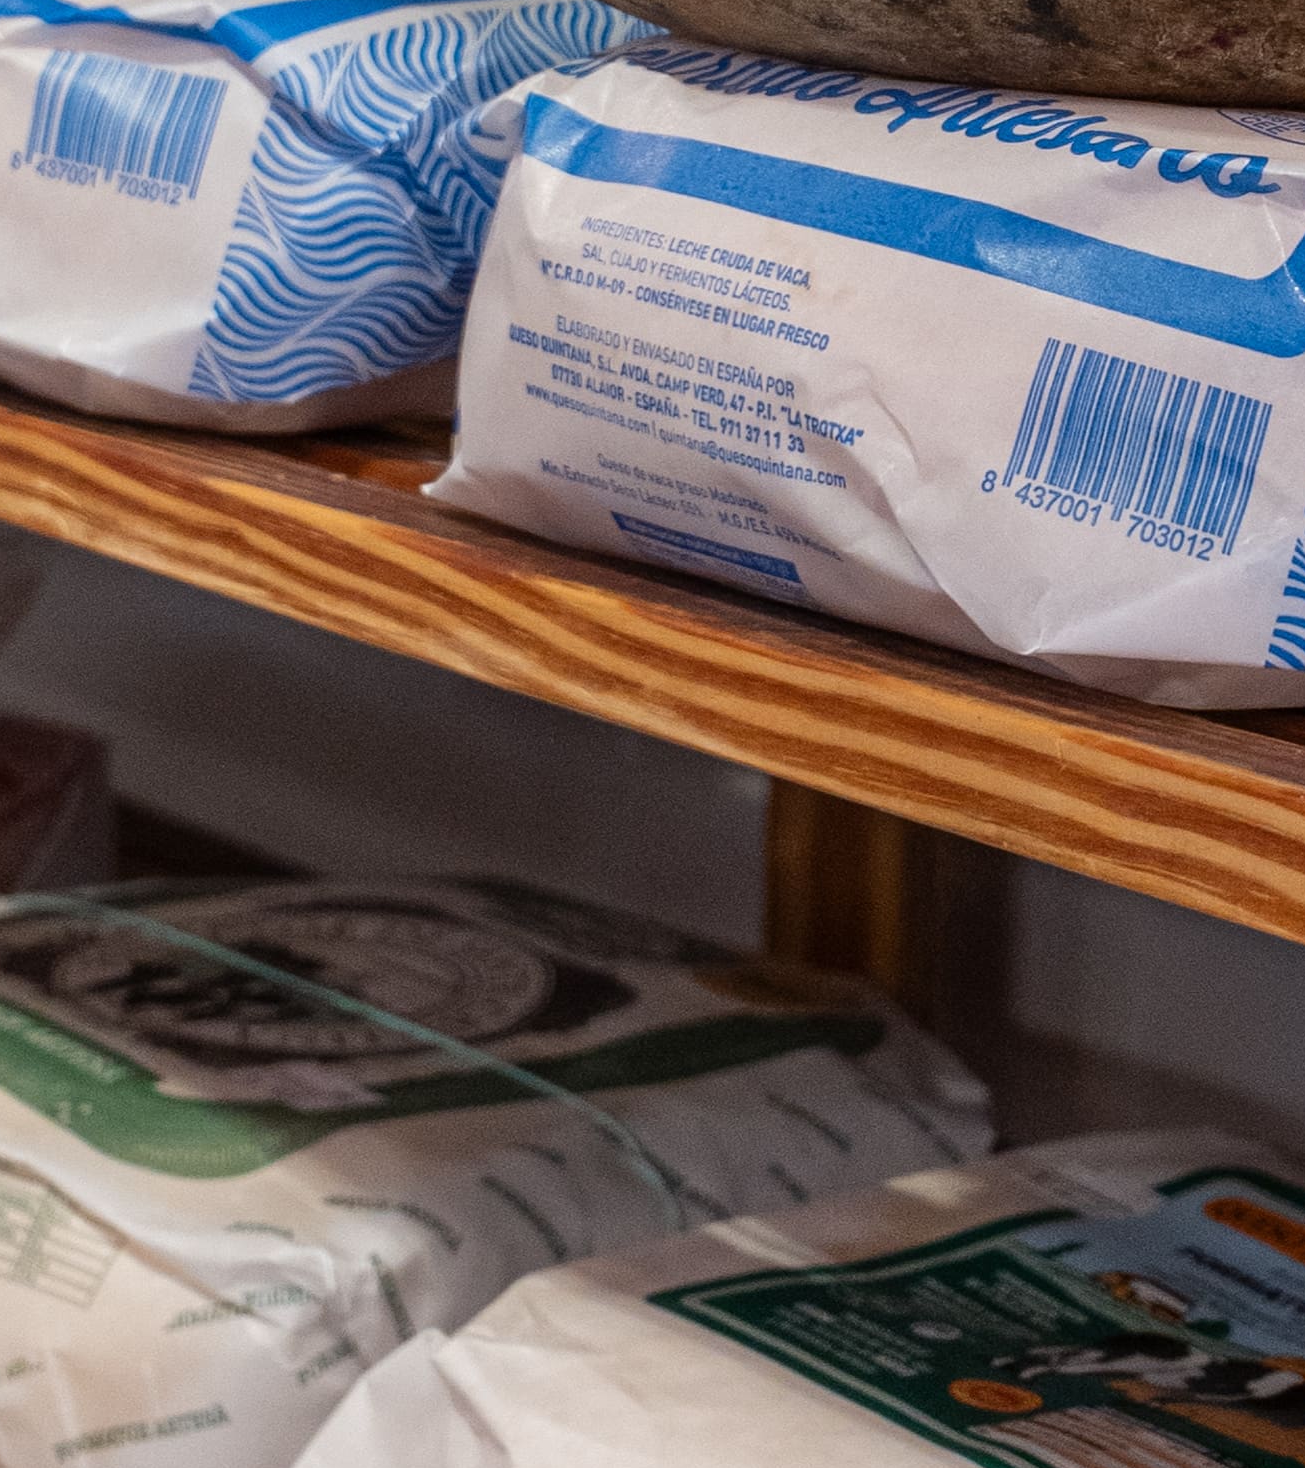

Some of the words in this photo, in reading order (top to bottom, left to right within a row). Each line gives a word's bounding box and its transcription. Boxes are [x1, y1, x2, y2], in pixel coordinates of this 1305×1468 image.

[582, 241, 606, 265] SAL,
[609, 248, 646, 275] CUAJO
[657, 261, 731, 298] FERMENTOS
[732, 275, 792, 313] LÁCTEOS.
[668, 236, 709, 262] LECHE
[711, 246, 754, 275] CRUDA
[756, 259, 774, 280] DE
[776, 263, 812, 291] VACA,
[635, 280, 711, 322] CONSÉRVESE
[713, 305, 731, 327] EN
[733, 309, 777, 340] LUGAR
[778, 321, 830, 354] FRESCO
[542, 334, 596, 370] QUINTANA,
[656, 370, 690, 398] CAMP
[692, 381, 727, 412] VERD,
[729, 392, 745, 414] 47
[803, 412, 865, 451] TROTXA"
[556, 314, 621, 351] ELABORADO
[632, 338, 695, 373] ENVASADO
[697, 355, 714, 378] EN
[717, 356, 764, 393] ESPAÑA
[766, 374, 796, 400] POR
[585, 372, 625, 404] ALAIOR
[635, 387, 680, 421] ESPAÑA
[691, 407, 717, 433] TEL.
[720, 416, 742, 441] 971
[745, 422, 761, 446] 37
[763, 426, 781, 451] 11
[788, 431, 805, 456] 33
[658, 423, 847, 497] quintana@quesoquintana.com
[980, 469, 998, 494] 8
[1014, 481, 1103, 527] 437001
[1125, 514, 1215, 562] 703012
